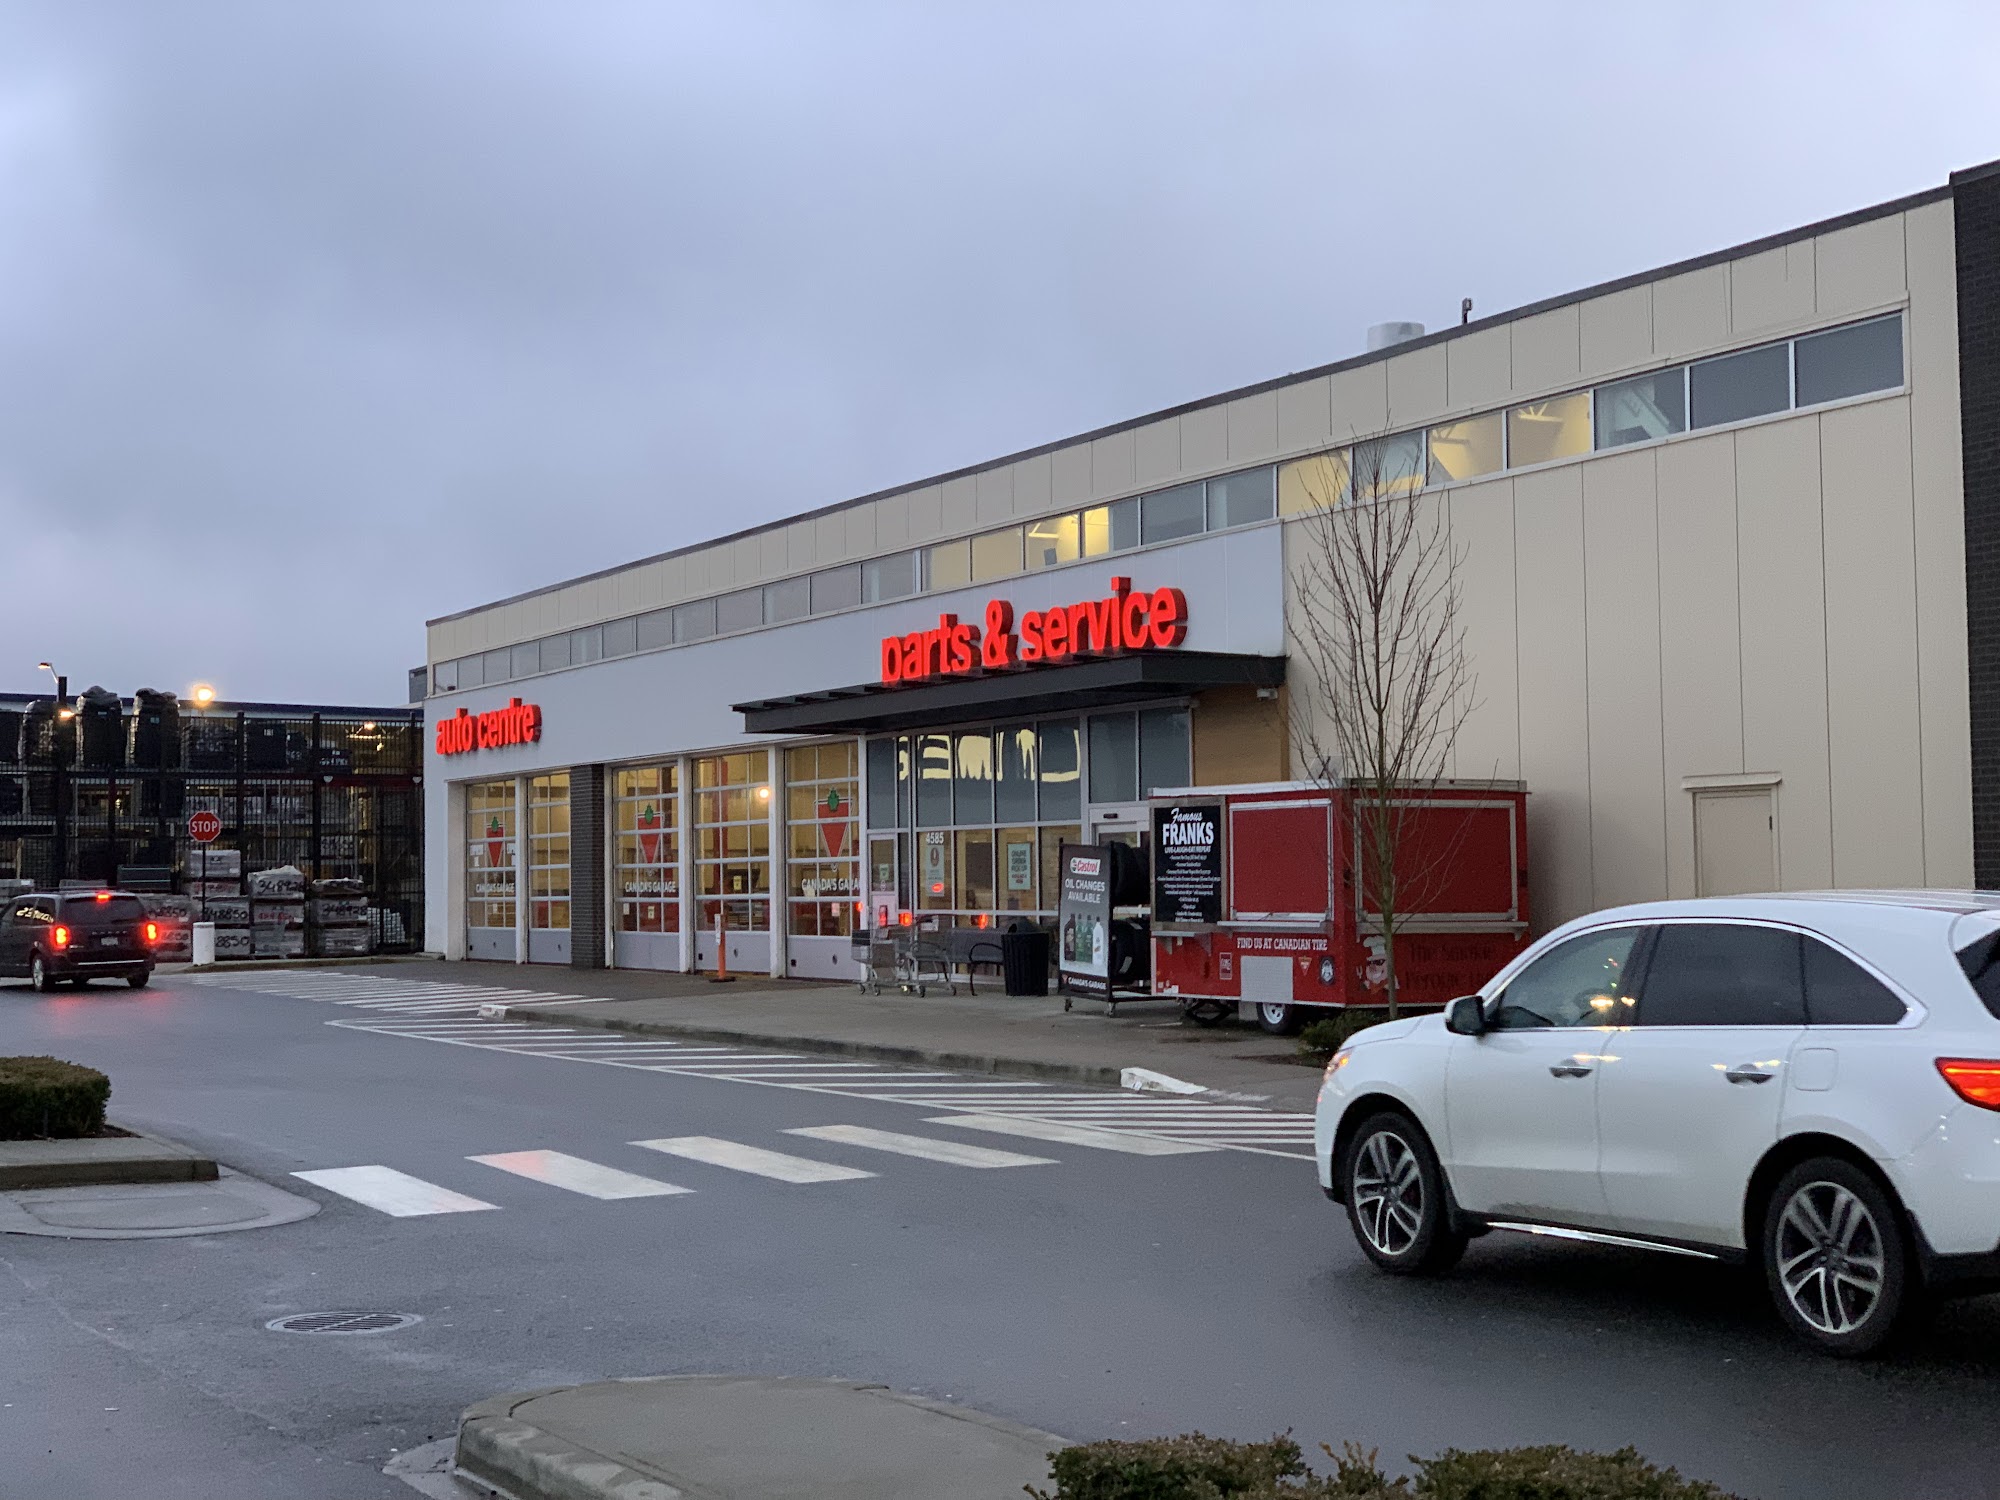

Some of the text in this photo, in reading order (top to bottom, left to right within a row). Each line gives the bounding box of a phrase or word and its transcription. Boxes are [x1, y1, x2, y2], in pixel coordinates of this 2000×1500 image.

[881, 577, 1186, 686] parts & service
[436, 698, 541, 755] auto centre
[1171, 808, 1203, 824] Famous
[191, 820, 217, 833] STOP
[1162, 821, 1215, 846] FRANKS
[1077, 860, 1098, 873] Castrol
[475, 883, 515, 893] CANDA'S GAAGE
[1065, 878, 1105, 892] OIL CHANGES
[1068, 891, 1101, 904] AVAILABLE
[1237, 937, 1328, 951] FIND US AT CANADIAN TIRE
